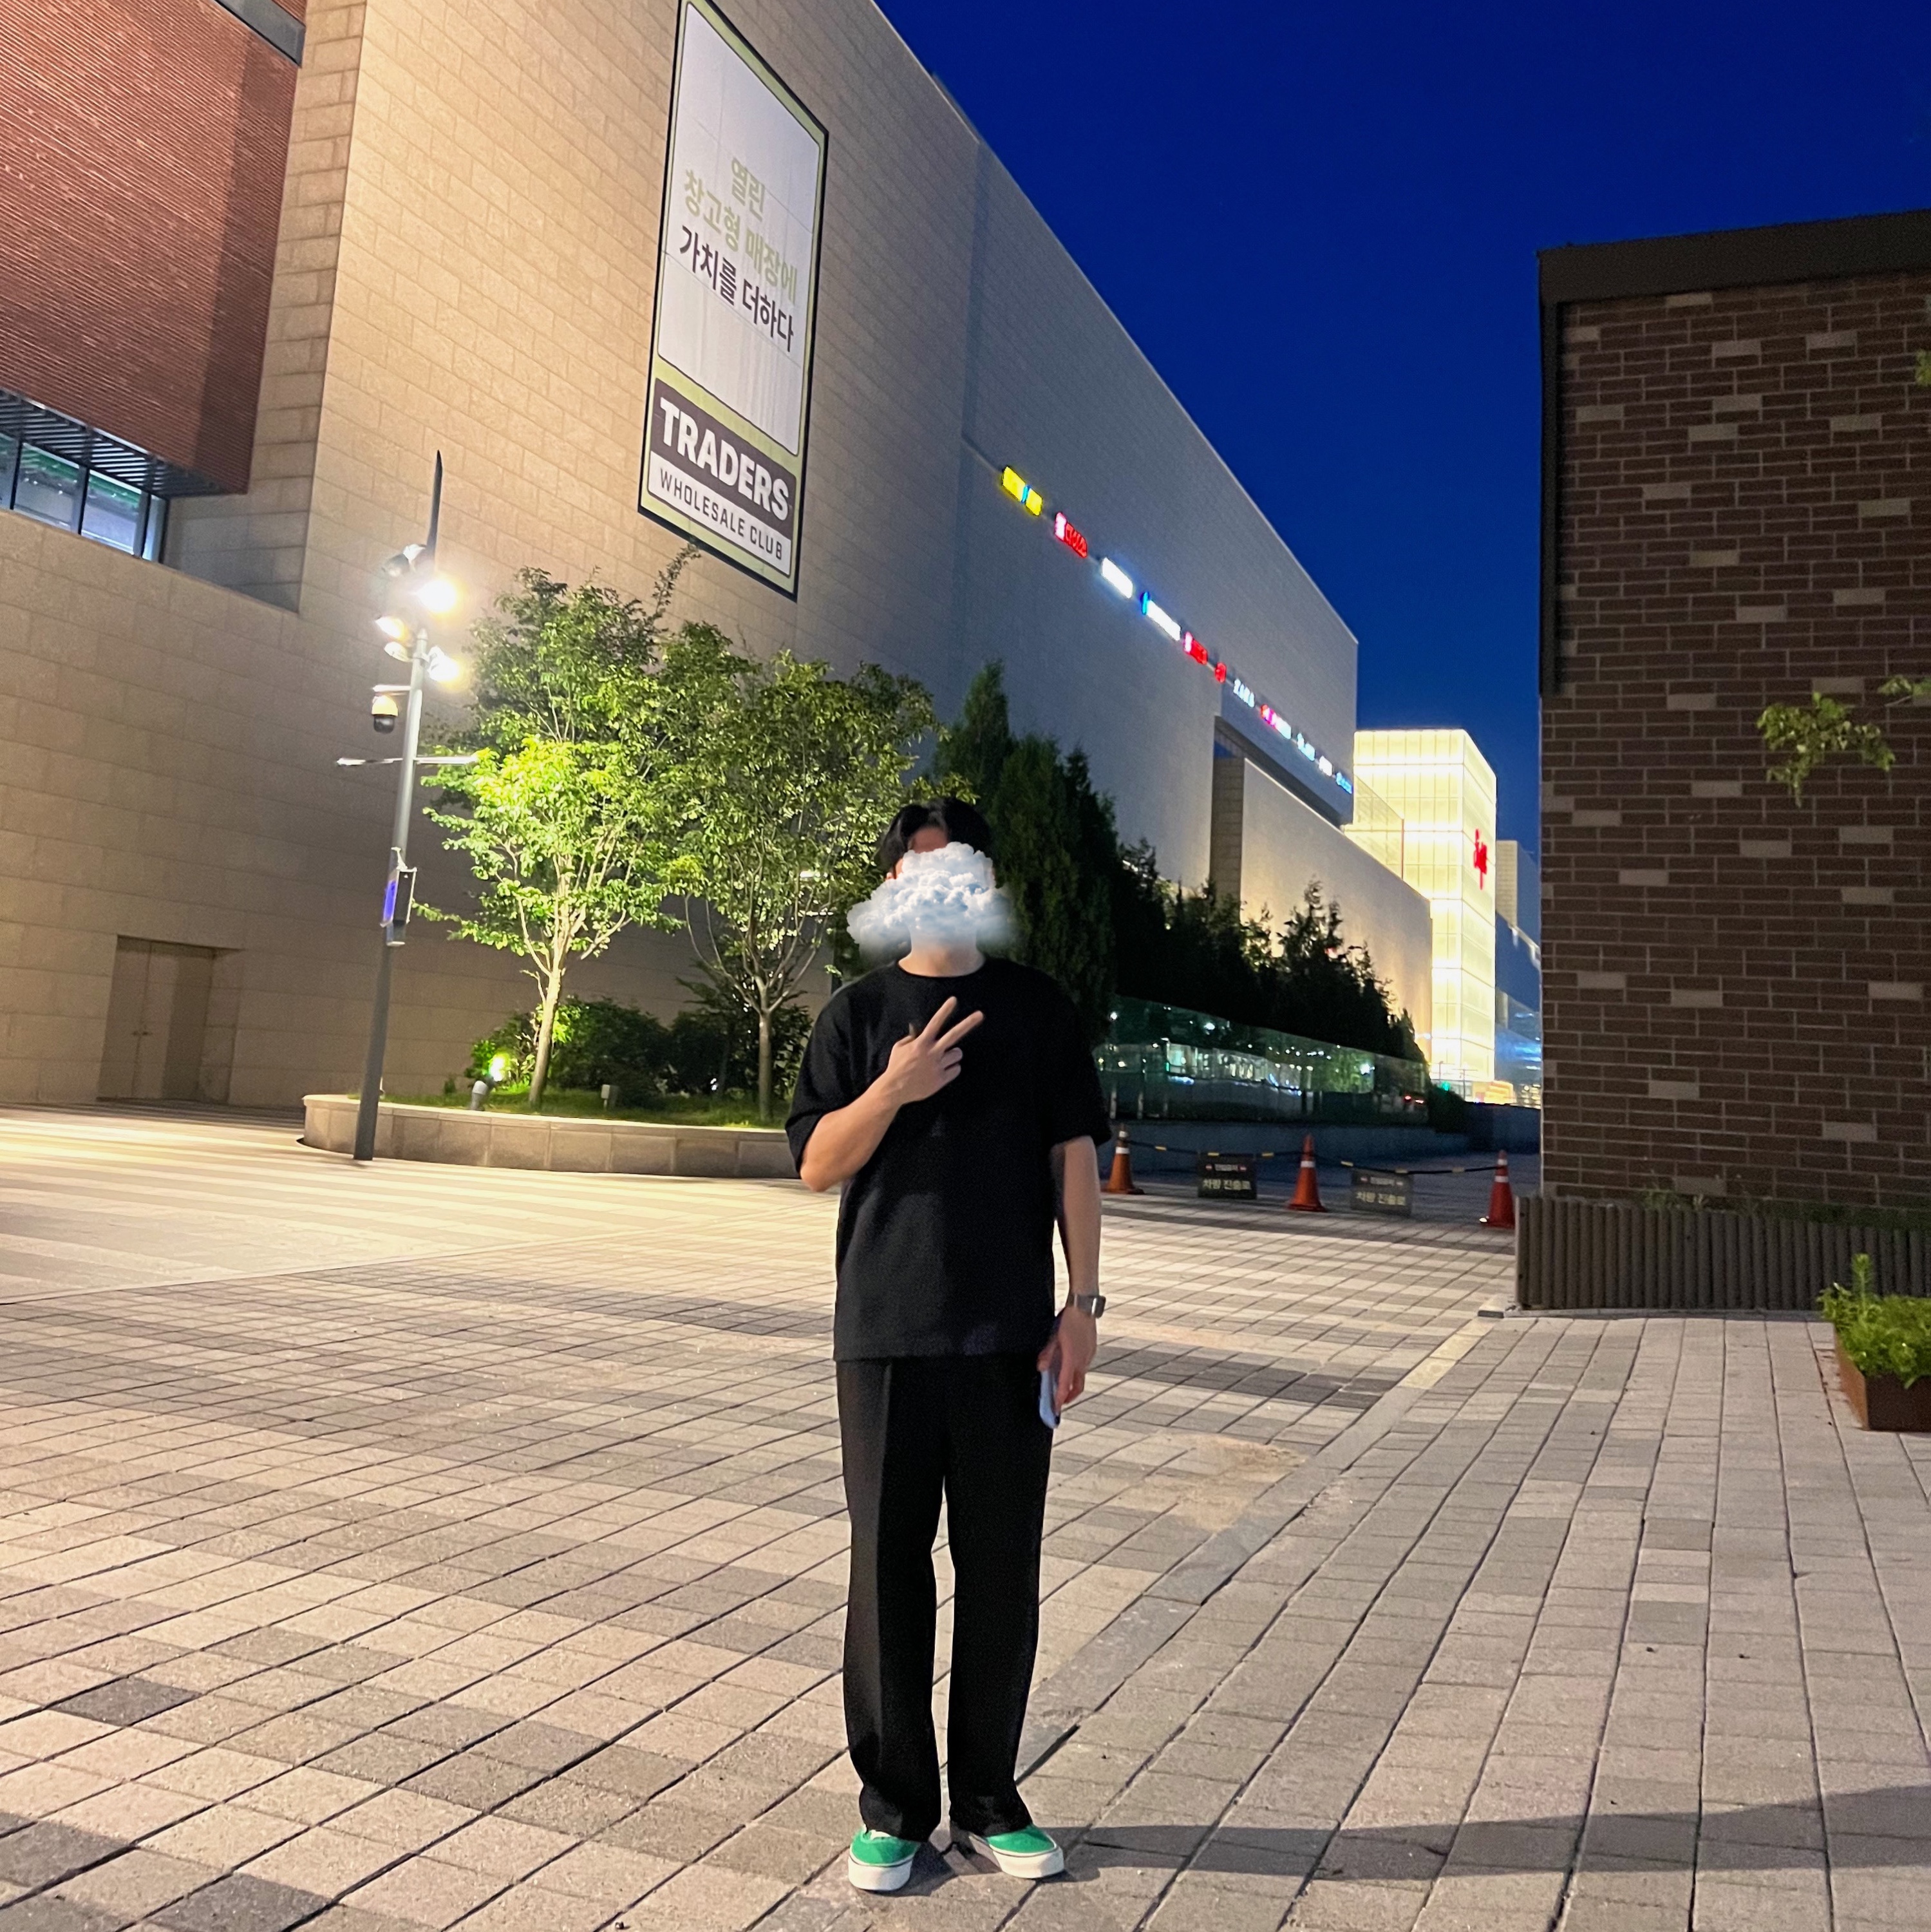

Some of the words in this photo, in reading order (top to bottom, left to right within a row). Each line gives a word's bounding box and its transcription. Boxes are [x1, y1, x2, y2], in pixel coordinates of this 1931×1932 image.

[684, 169, 740, 252] 창고형
[745, 227, 798, 305] 매장에
[731, 158, 765, 222] 열린
[679, 225, 737, 306] 가치를
[742, 278, 794, 352] 더하다
[660, 397, 789, 520] TRADERS
[660, 468, 744, 538] WHOLESALE
[750, 526, 782, 560] CLUB
